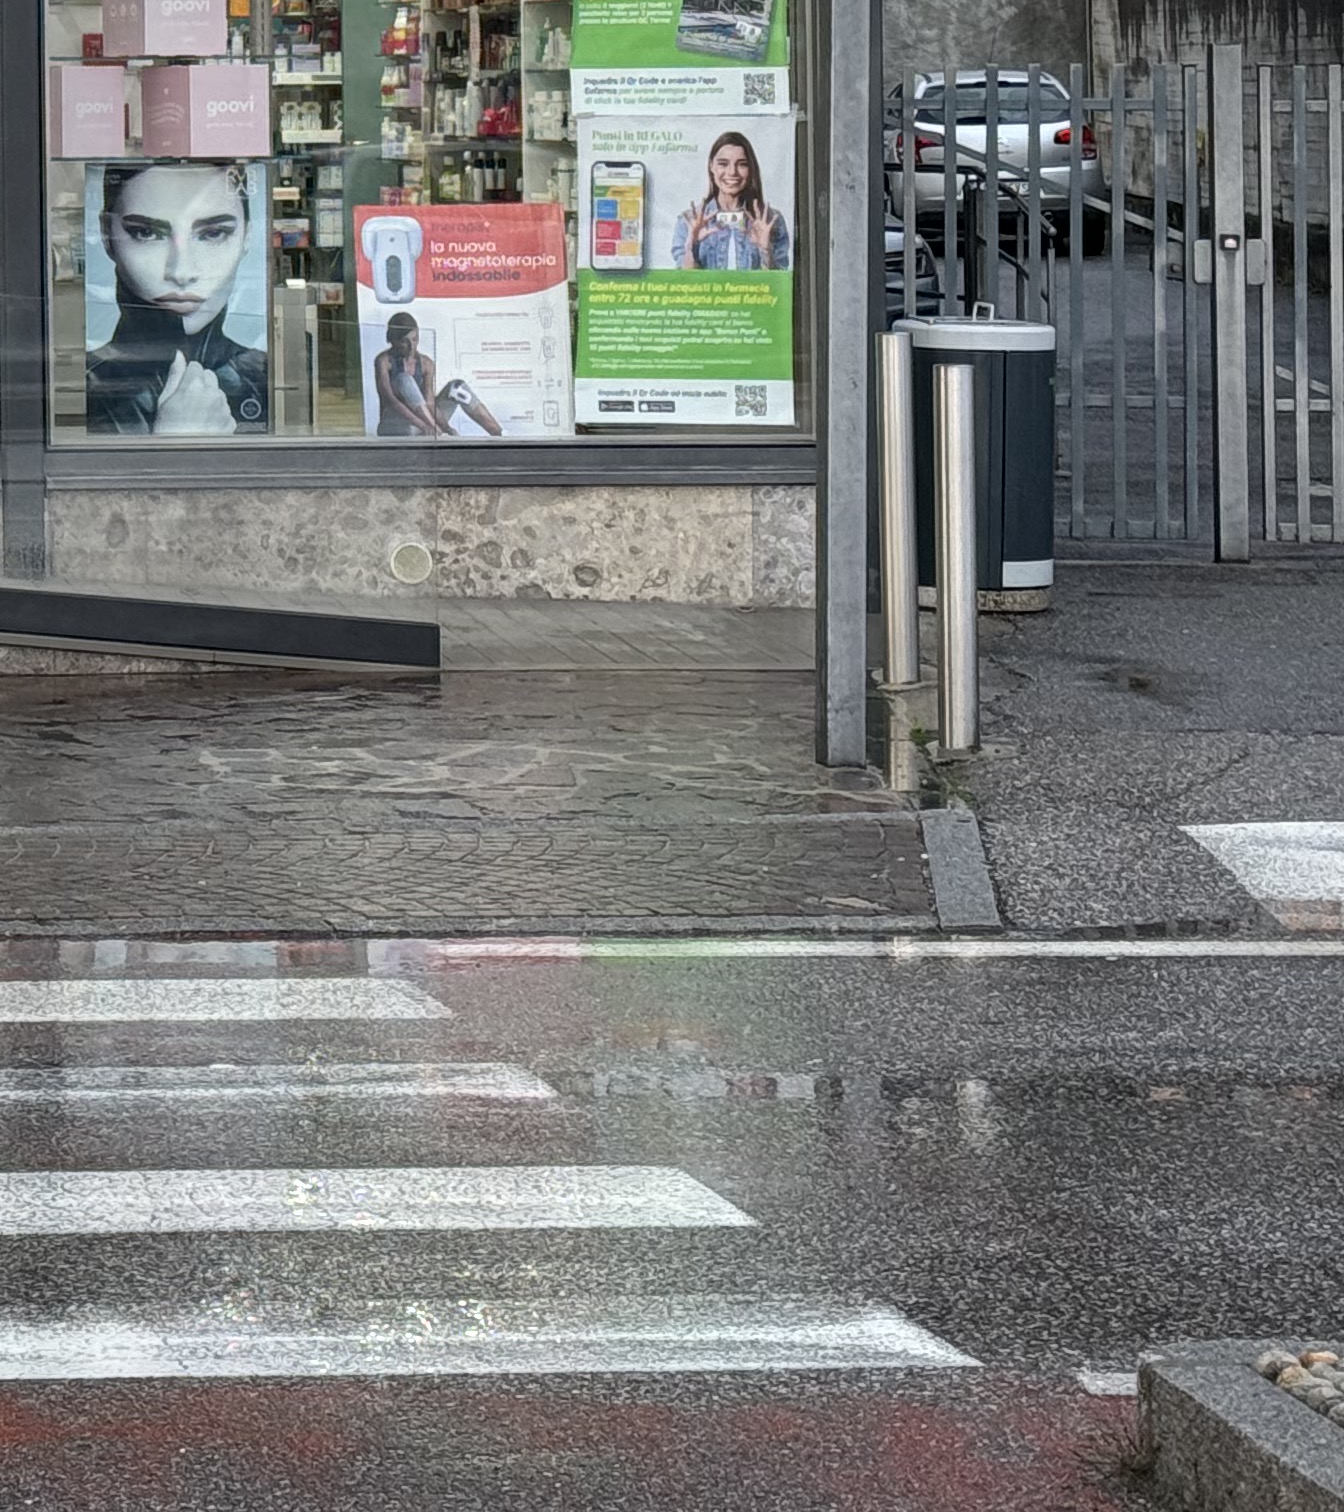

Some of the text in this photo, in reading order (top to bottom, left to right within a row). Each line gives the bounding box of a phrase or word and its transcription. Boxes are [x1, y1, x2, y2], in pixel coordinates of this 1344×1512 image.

[75, 96, 114, 118] goovi
[206, 94, 255, 117] goovi
[430, 240, 497, 253] la nuova
[430, 253, 557, 271] magnetoterapia
[432, 269, 521, 282] indossabile
[588, 282, 640, 292] Conferma
[647, 282, 668, 292] tuoi
[670, 282, 711, 295] acquisti
[713, 283, 723, 292] in
[724, 282, 770, 294] farmacia
[588, 294, 616, 303] entro
[618, 294, 631, 303] 72
[633, 296, 652, 304] ore
[662, 294, 712, 306] guadagna
[714, 294, 742, 306] punti
[743, 294, 778, 307] fidelity
